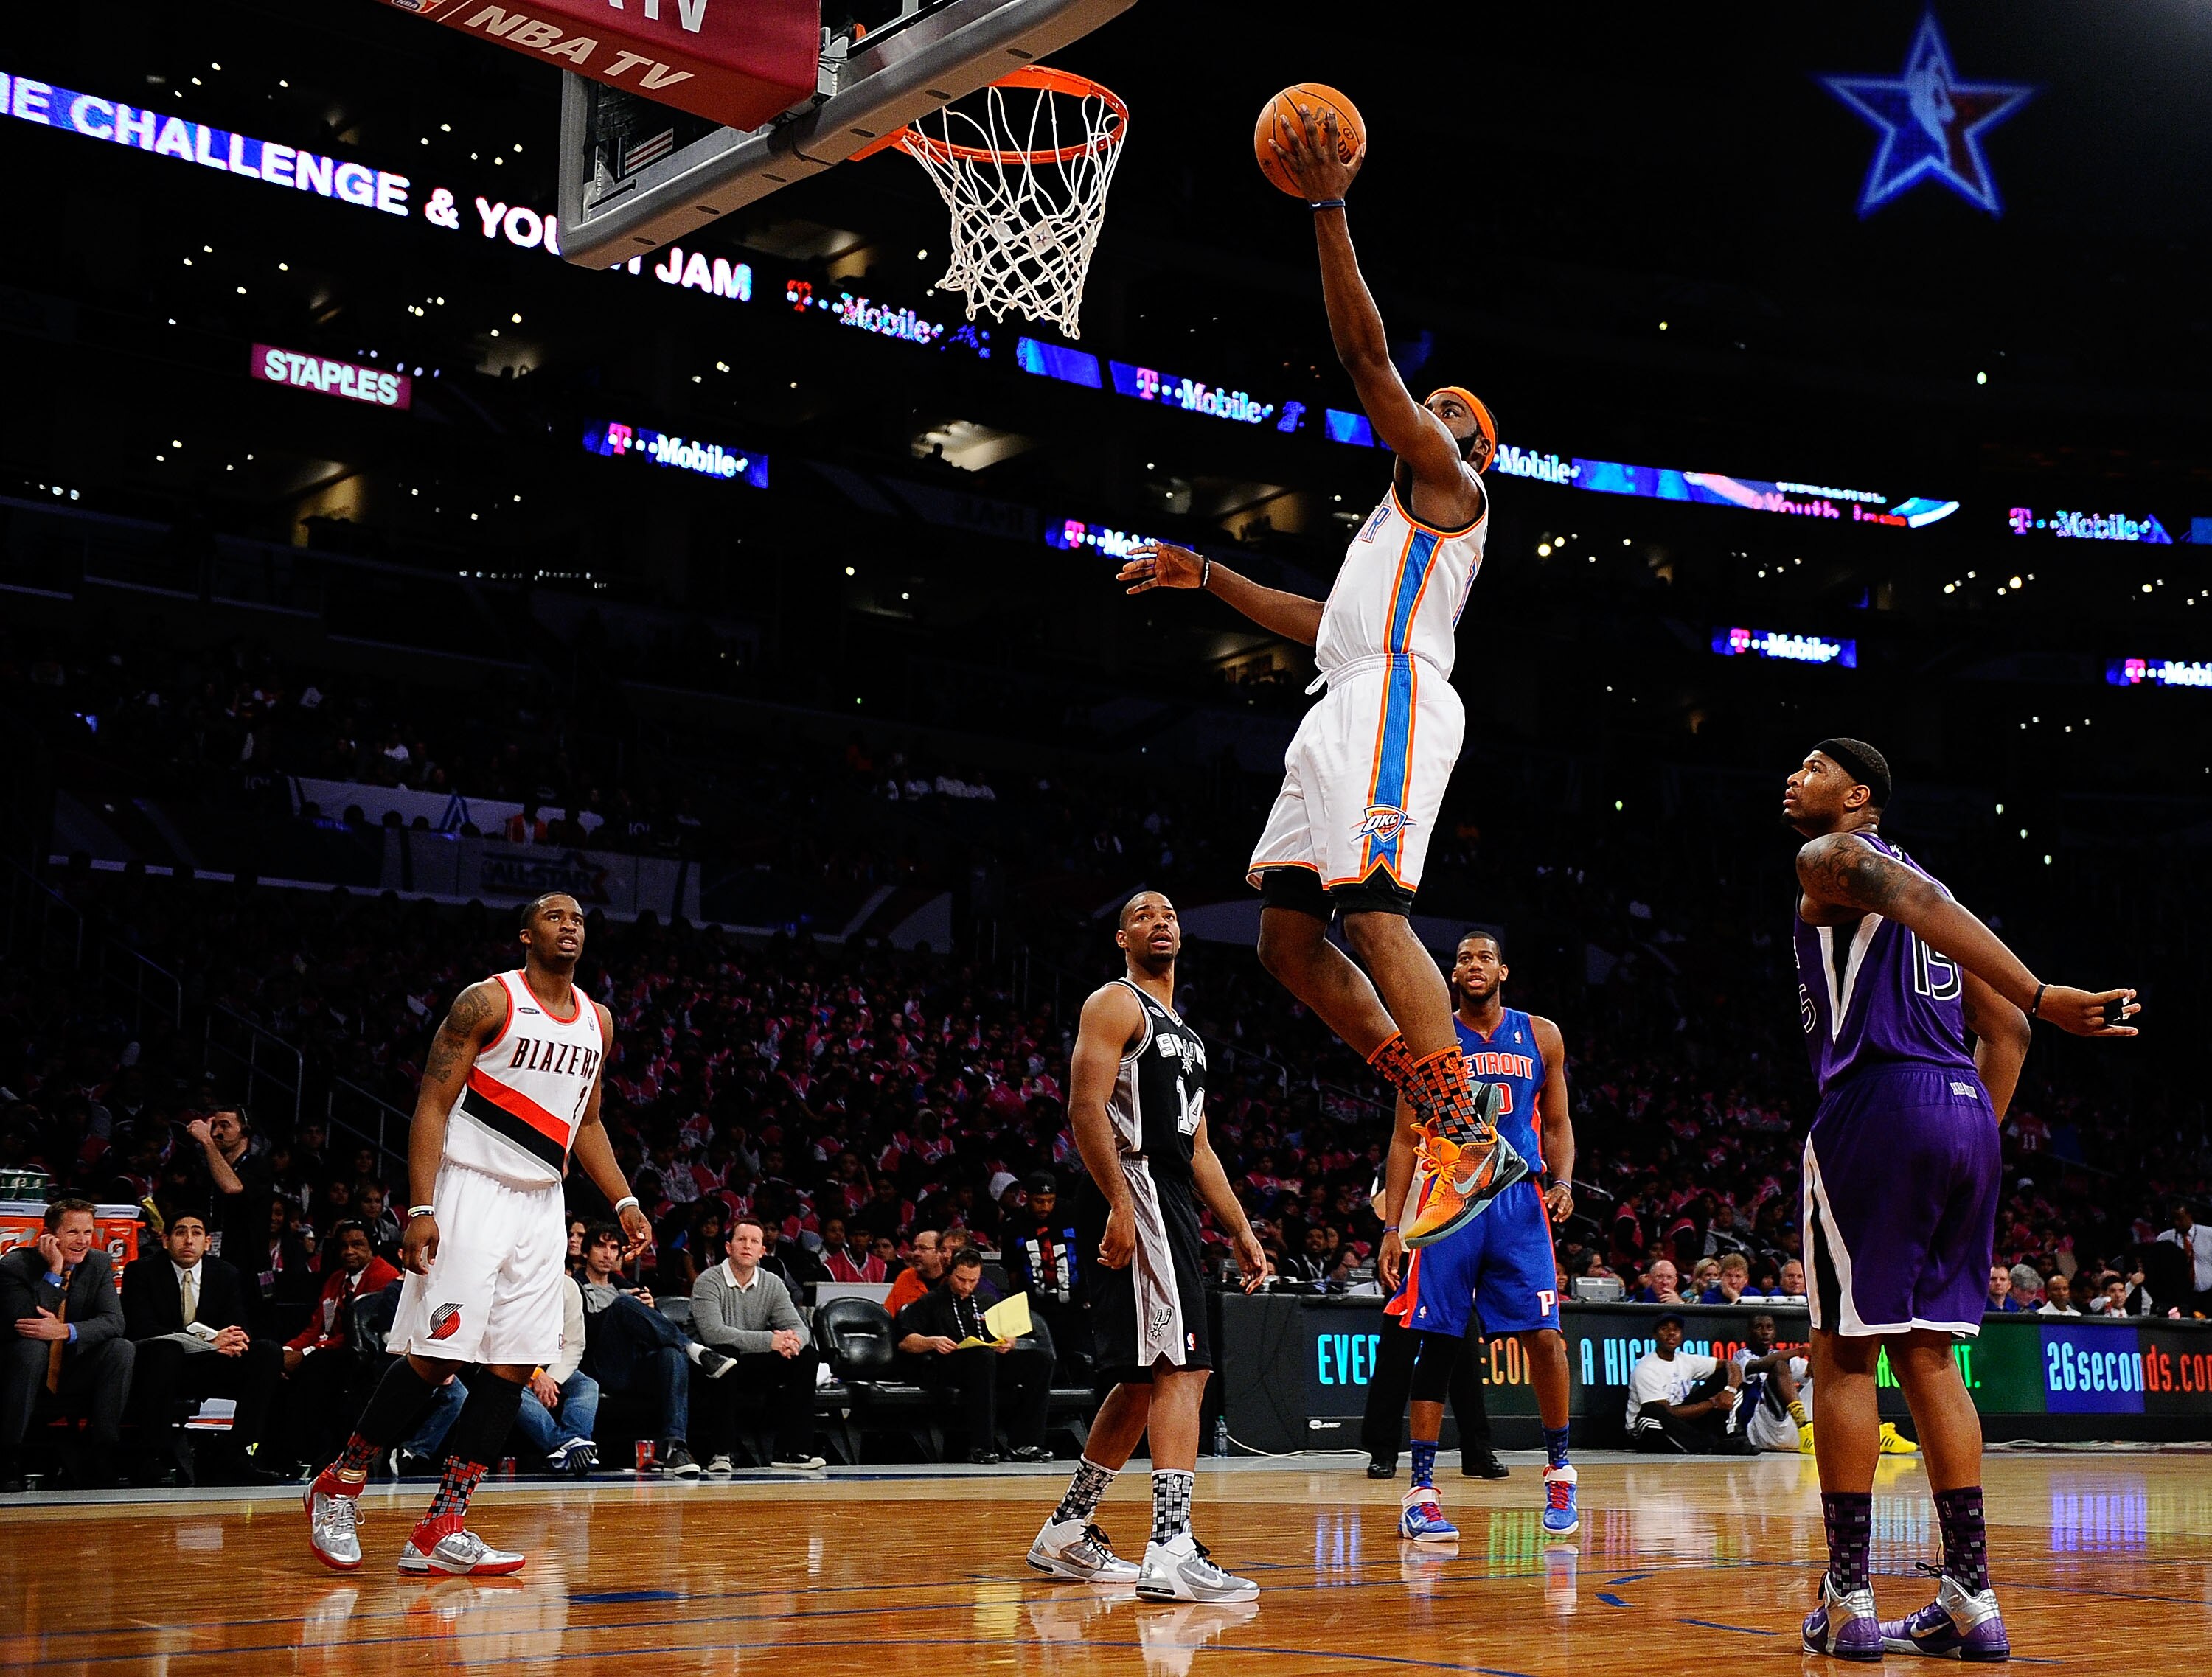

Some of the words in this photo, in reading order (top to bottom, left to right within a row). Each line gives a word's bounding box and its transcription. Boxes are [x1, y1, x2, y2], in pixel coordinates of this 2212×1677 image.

[464, 4, 598, 65] NBA
[602, 50, 695, 90] TV
[0, 72, 52, 125] E
[70, 94, 411, 216] CHALLENGE
[425, 188, 459, 229] &
[655, 247, 752, 302] JAM
[264, 349, 399, 405] STAPLES
[1494, 444, 1581, 484] Mobile
[1361, 813, 1399, 833] OKC
[1911, 930, 1961, 1001] 15
[1799, 983, 1817, 1033] 5
[507, 1036, 599, 1081] BLAZERS
[1462, 1051, 1534, 1080] ETROIT
[1176, 1075, 1206, 1136] 14
[1537, 1290, 1555, 1317] P
[1580, 1338, 1595, 1386] A
